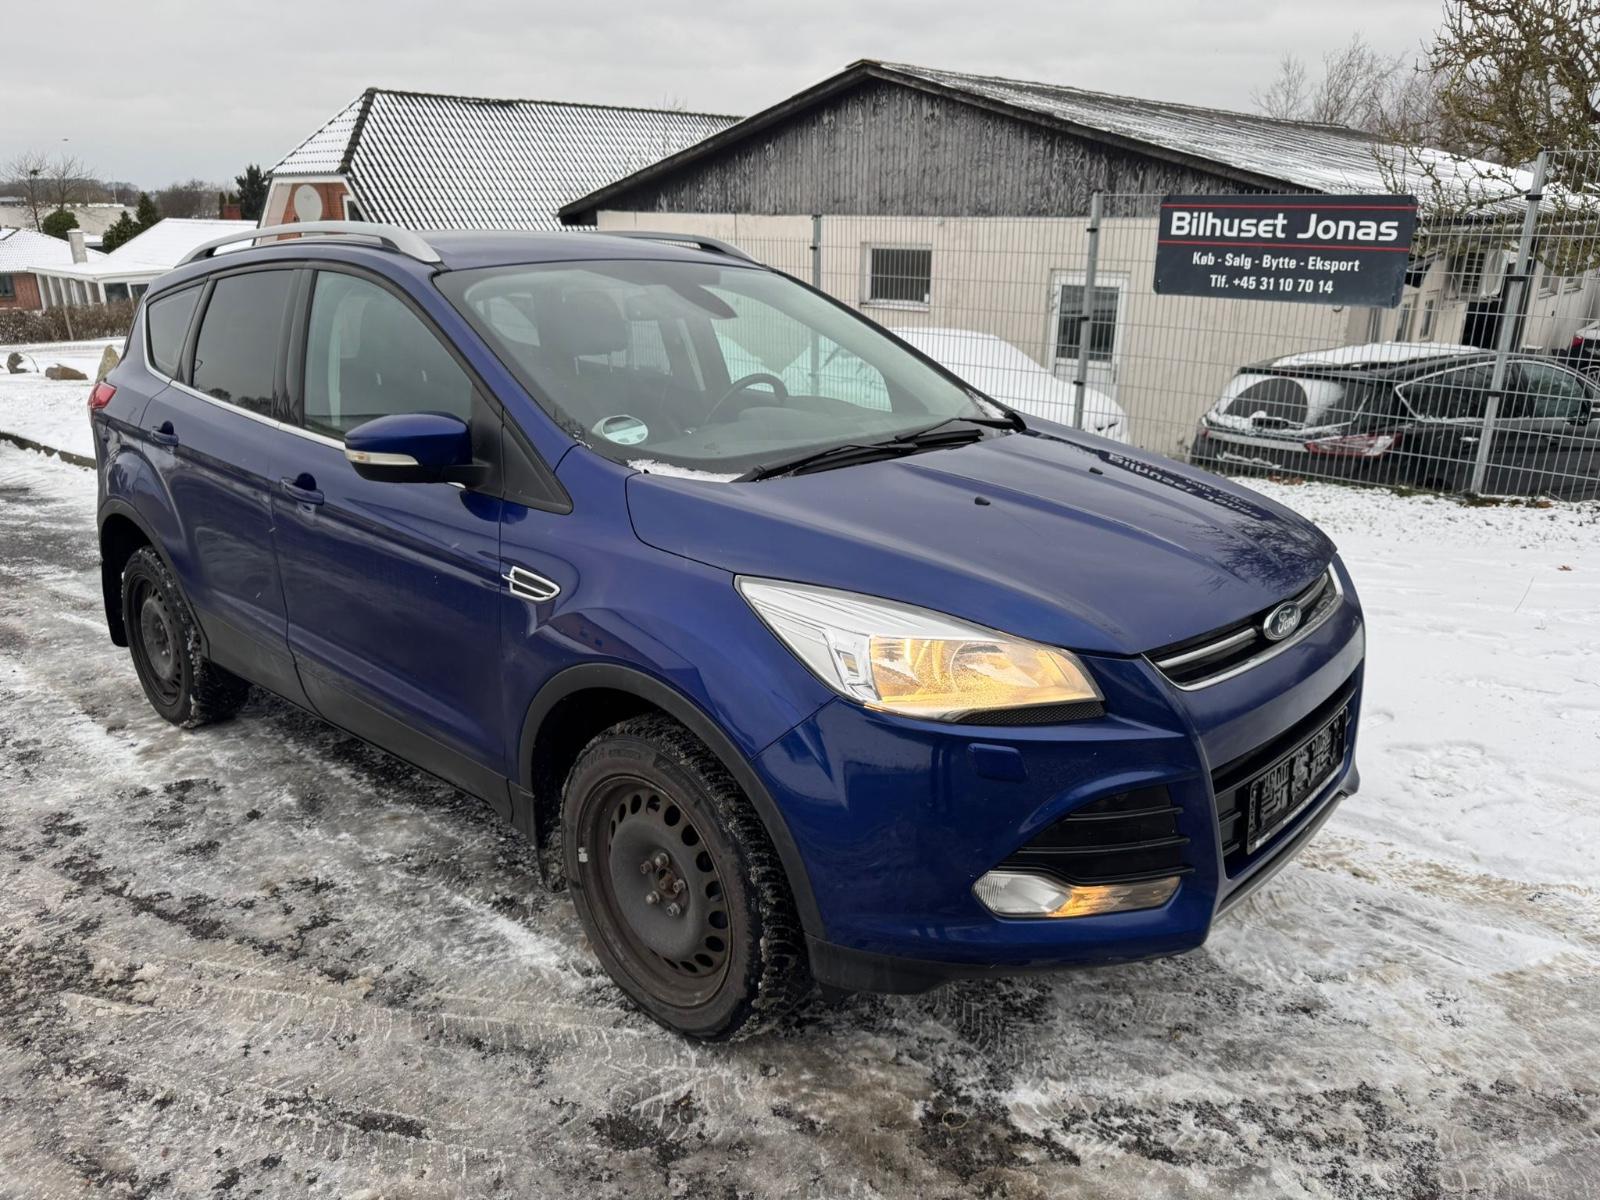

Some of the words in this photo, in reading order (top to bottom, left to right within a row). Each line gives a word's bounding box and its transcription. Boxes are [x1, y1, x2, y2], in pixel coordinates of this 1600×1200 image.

[1170, 211, 1287, 238] Bilhuset
[1296, 213, 1399, 241] Jonas
[1192, 251, 1215, 266] Køb
[1224, 253, 1252, 270] Salg
[1262, 254, 1297, 271] Bytte
[1307, 256, 1360, 274] Eksport
[1210, 274, 1229, 288] Tlf.
[1232, 276, 1257, 289] +45
[1259, 277, 1275, 291] 31
[1278, 278, 1294, 292] 10
[1297, 278, 1314, 293] 70
[1318, 280, 1334, 294] 14
[1277, 607, 1297, 633] Ford
